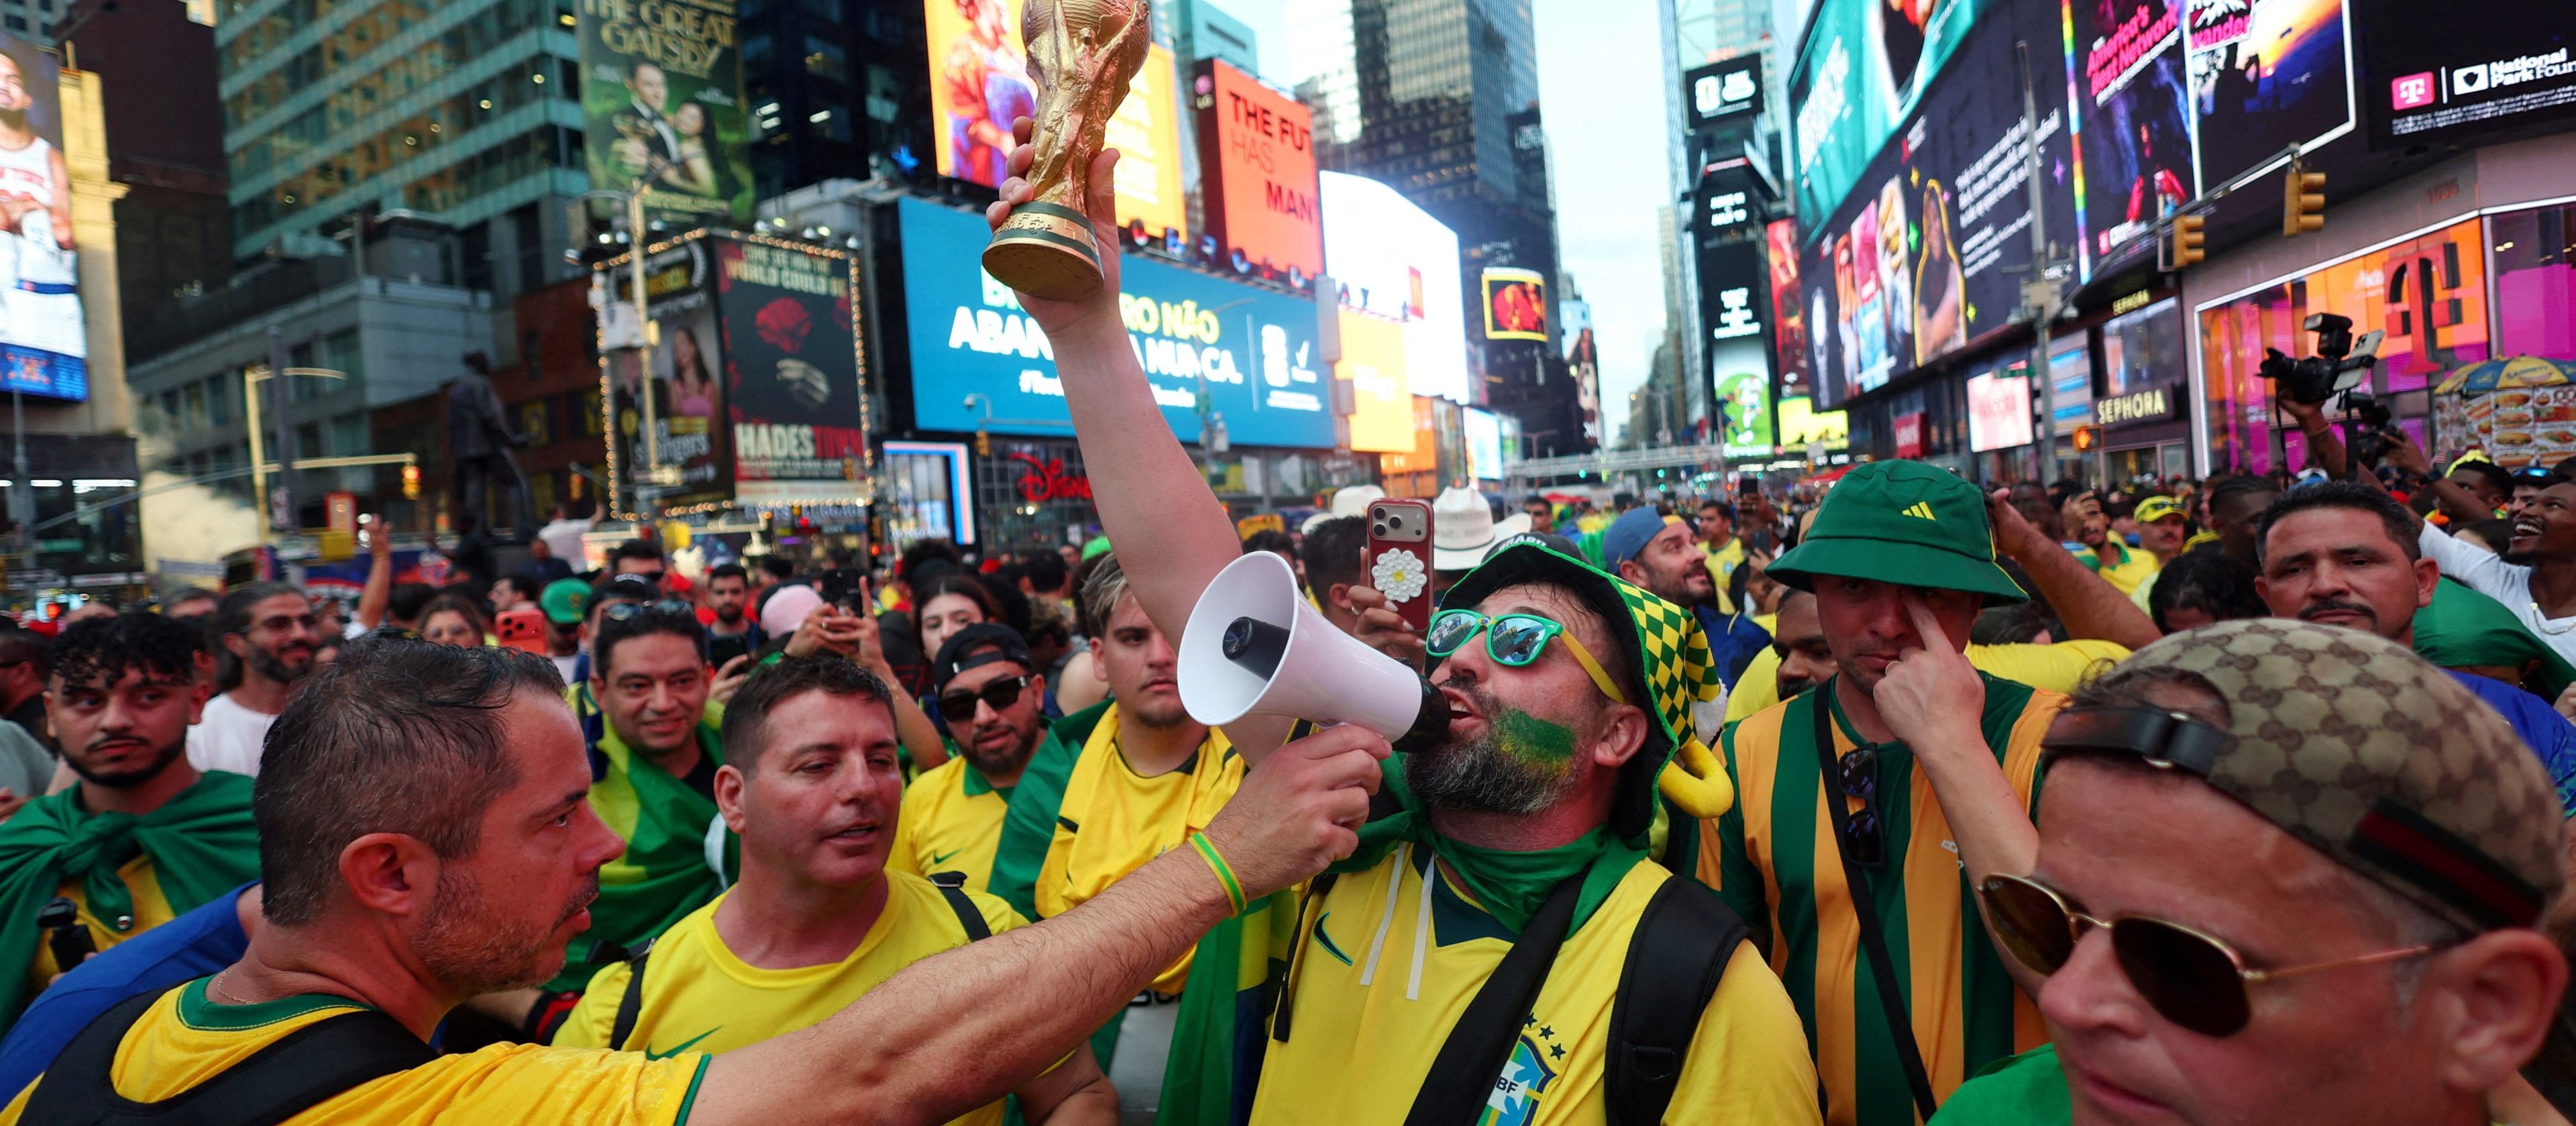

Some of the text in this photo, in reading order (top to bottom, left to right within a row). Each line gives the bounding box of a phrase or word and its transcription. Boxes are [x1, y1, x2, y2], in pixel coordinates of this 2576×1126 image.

[600, 20, 721, 68] GATSBY
[639, 1, 735, 47] GREAT
[2086, 5, 2150, 78] America's
[2190, 14, 2251, 51] wander
[2091, 54, 2119, 97] Best
[2118, 3, 2180, 74] Network
[2489, 47, 2567, 76] National
[2491, 68, 2536, 88] Park
[1228, 90, 1273, 137] THE
[1230, 127, 1275, 175] HAS
[1265, 178, 1314, 224] MAN
[723, 258, 780, 287] WORLD
[781, 268, 828, 296] COULD
[1161, 299, 1220, 345] NÃO
[1144, 336, 1244, 385] NUNCA.
[2097, 388, 2167, 425] SEPHORA
[1495, 1076, 1519, 1094] BF
